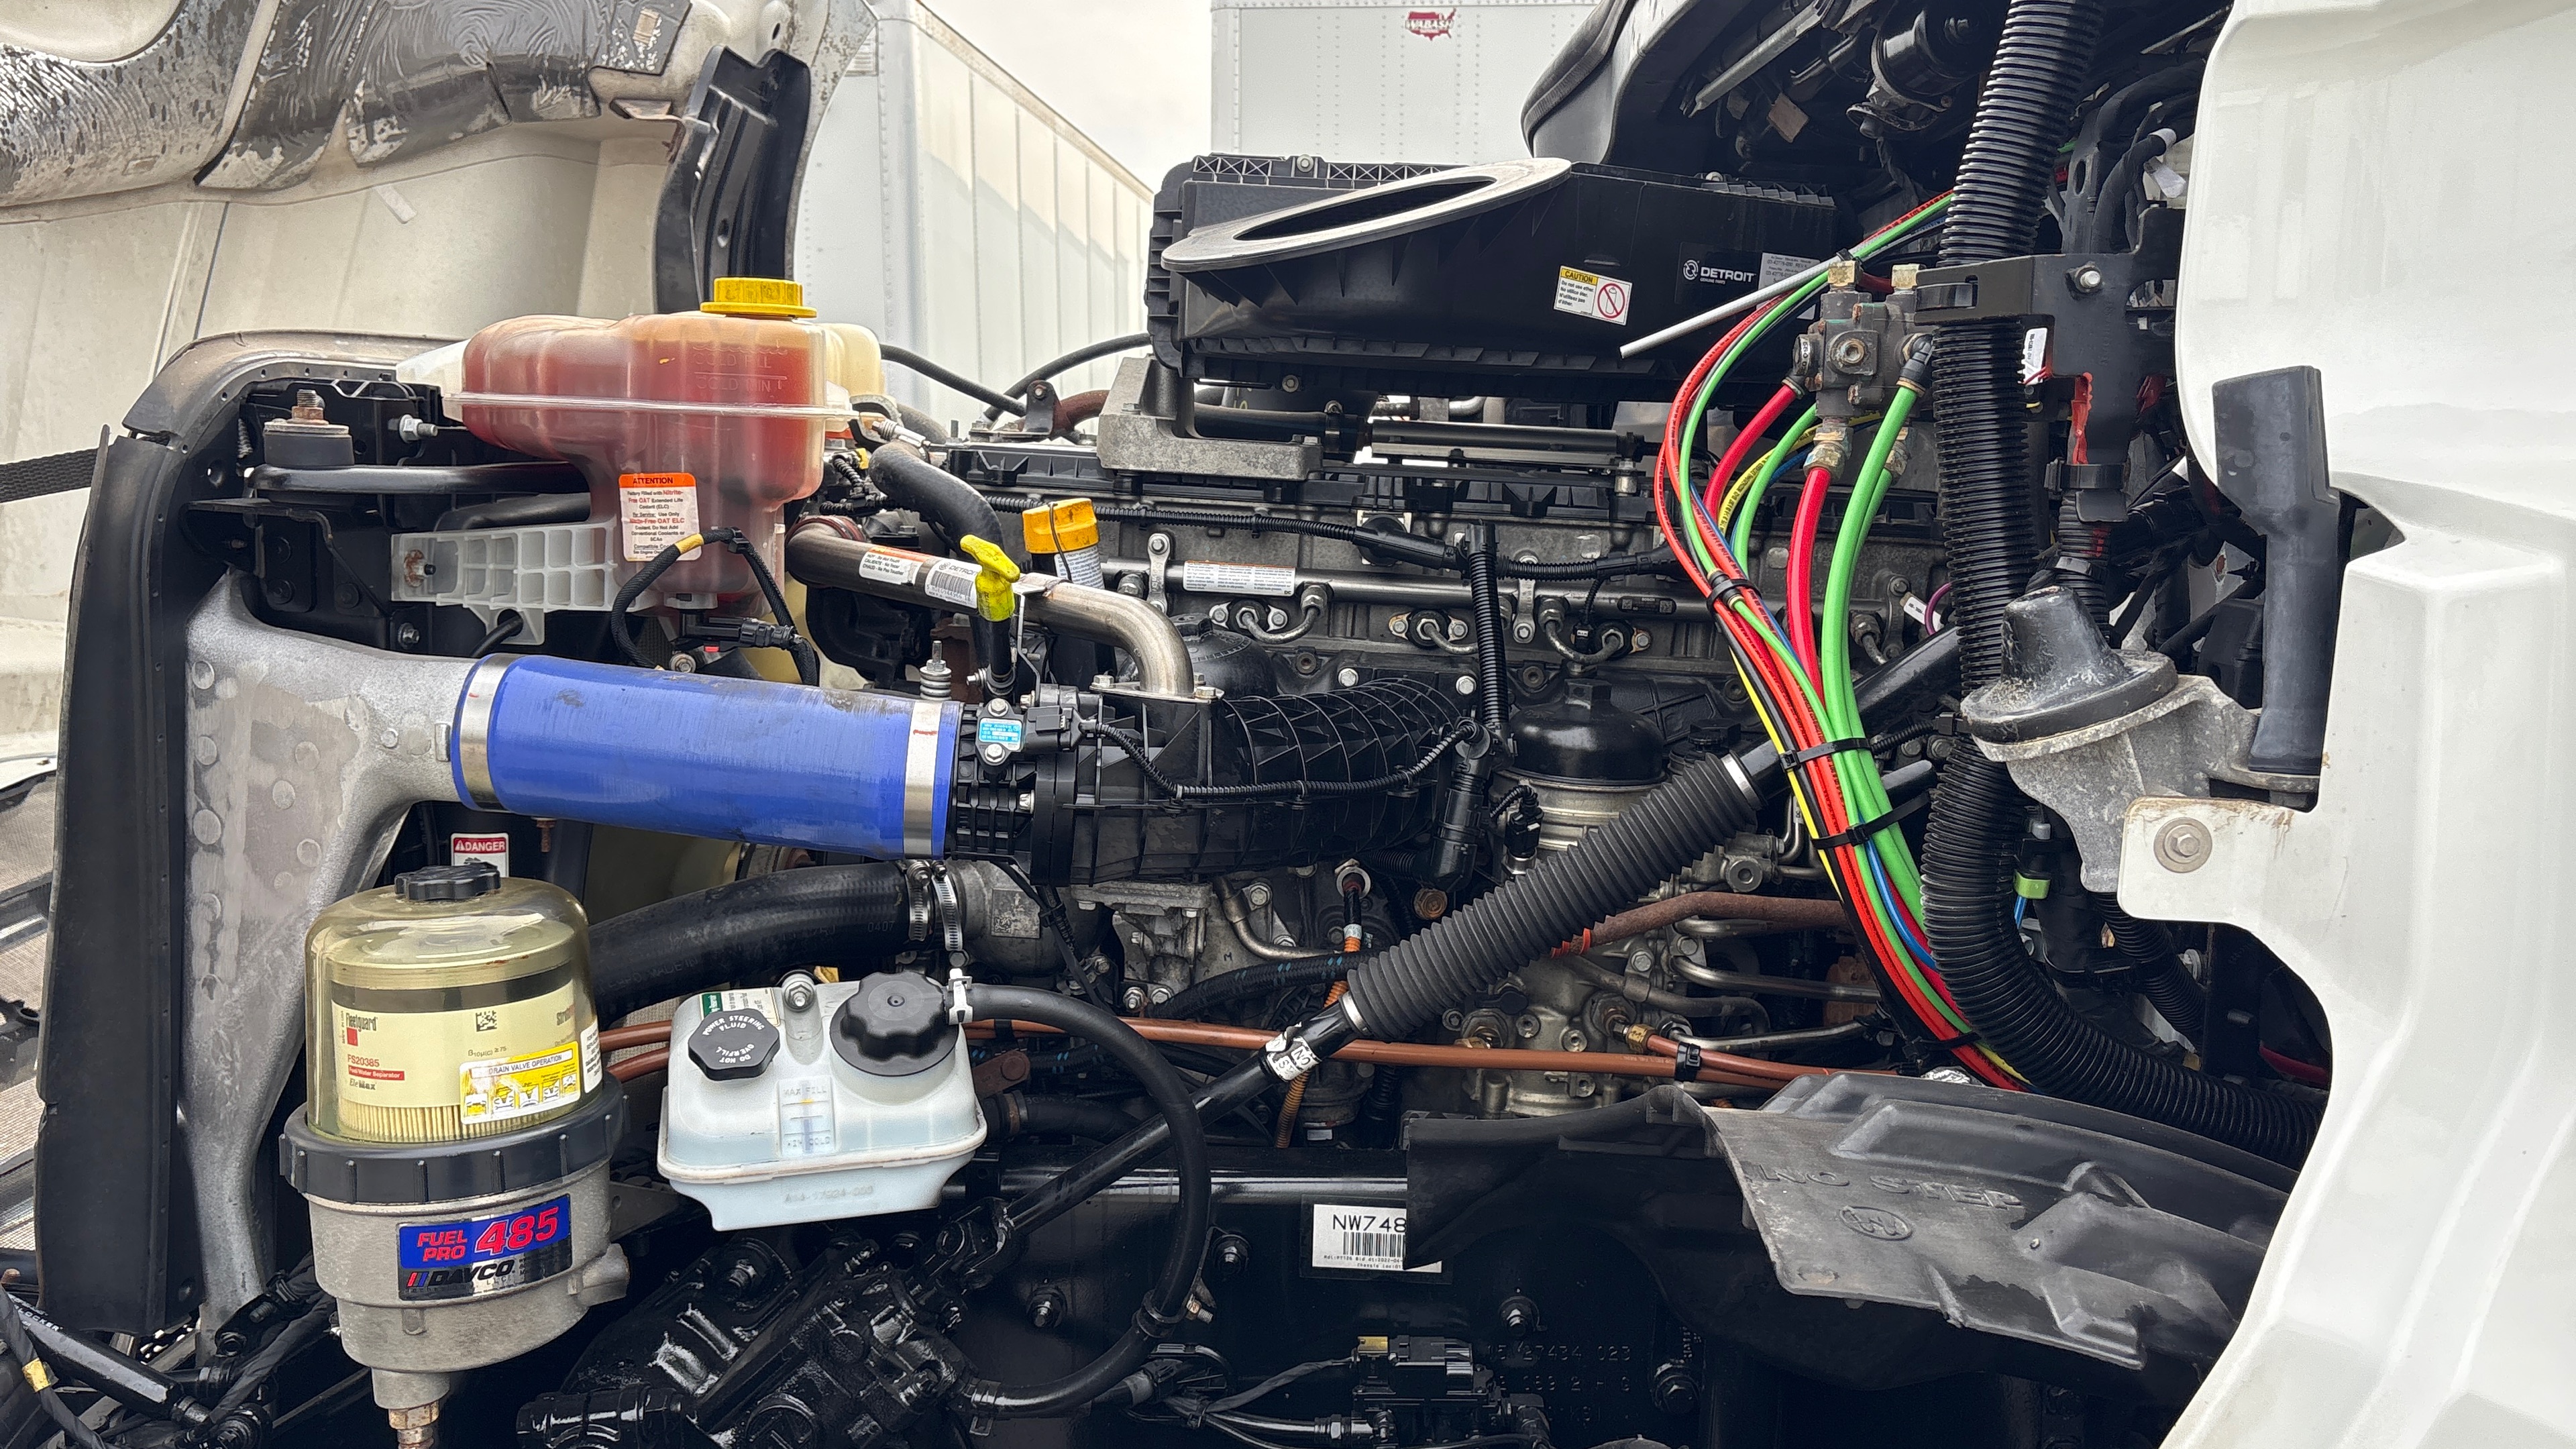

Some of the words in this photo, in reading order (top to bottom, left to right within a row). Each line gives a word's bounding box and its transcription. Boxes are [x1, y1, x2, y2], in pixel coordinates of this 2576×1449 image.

[1565, 270, 1593, 283] CAUTION
[1700, 266, 1756, 282] DETROIT
[745, 355, 771, 368] FLL
[464, 841, 506, 851] DANGER
[867, 920, 896, 932] 0407
[346, 1012, 378, 1032] Fleetguard
[702, 1018, 725, 1036] POWER
[729, 1015, 765, 1031] STEERING
[718, 1022, 747, 1031] FLUID
[715, 1043, 755, 1057] OVERFILL
[347, 1054, 380, 1067] FS20385
[488, 1066, 510, 1074] DRAIN
[511, 1061, 531, 1071] VALVE
[532, 1055, 562, 1068] OPERATION
[739, 1054, 751, 1062] DO
[372, 1071, 400, 1079] Separator
[783, 1088, 801, 1096] MAX
[1869, 1173, 2023, 1211] STEP
[474, 1205, 559, 1256] 485
[1332, 1214, 1407, 1233] NW748
[417, 1230, 468, 1248] FUEL
[423, 1245, 467, 1263] PRO
[428, 1259, 516, 1287] DAVCO
